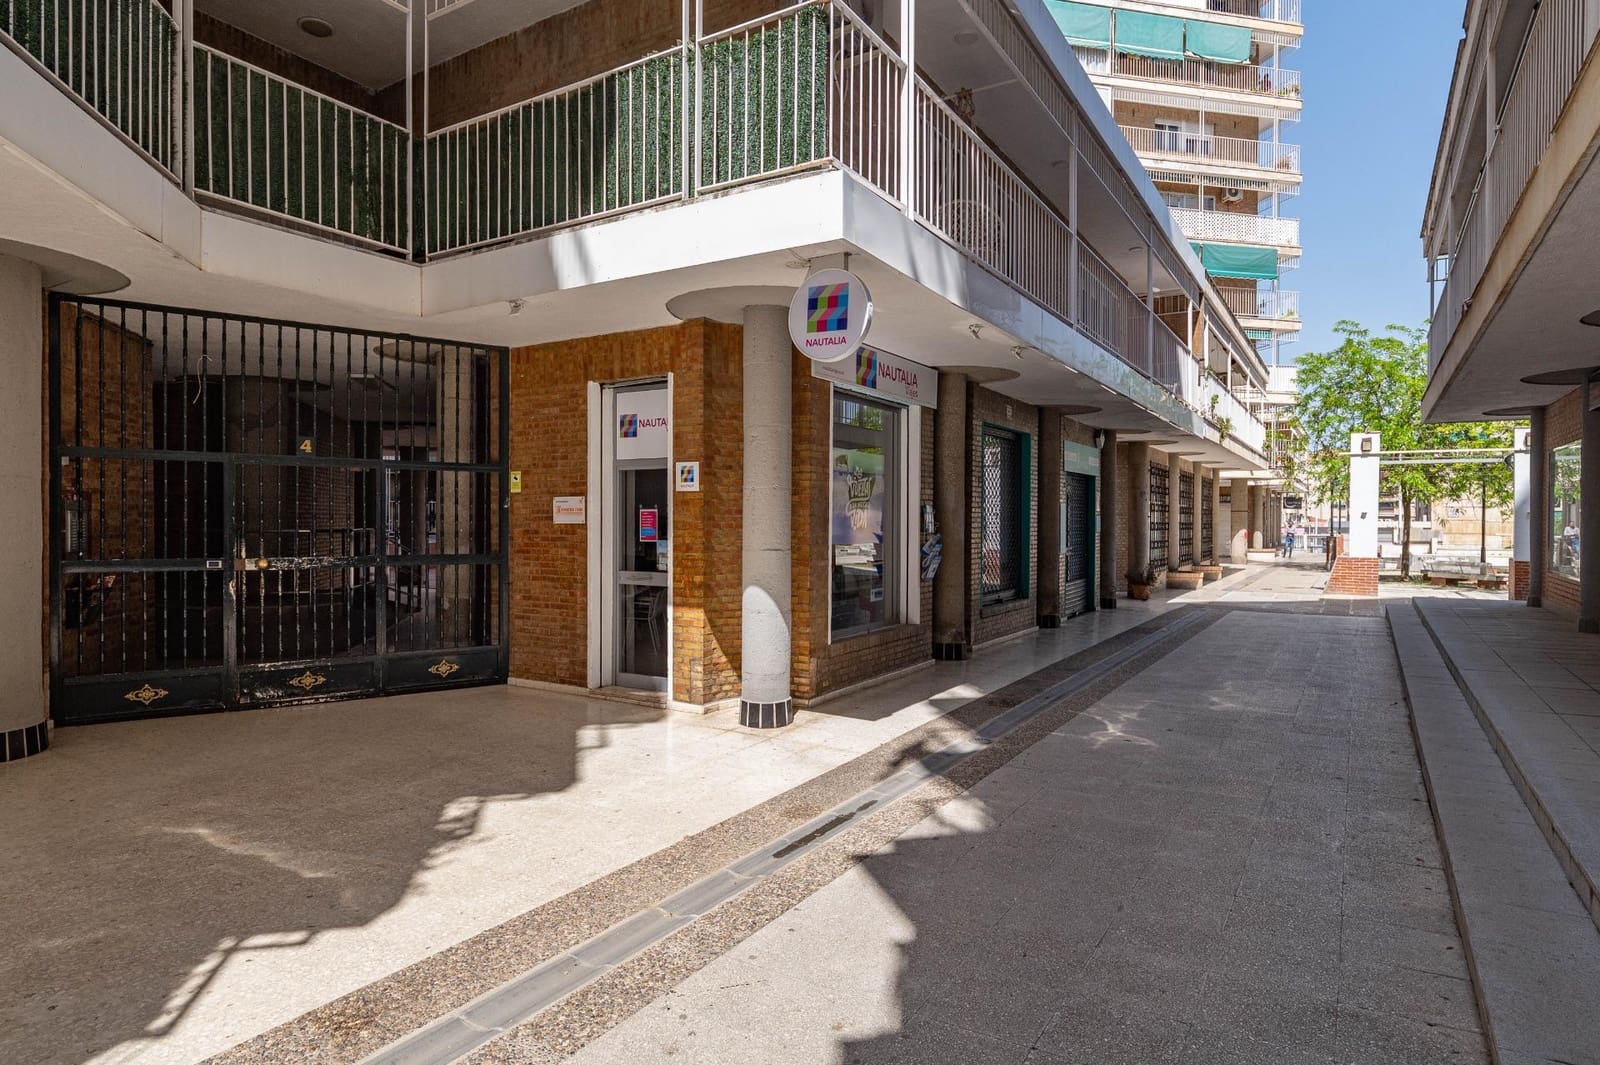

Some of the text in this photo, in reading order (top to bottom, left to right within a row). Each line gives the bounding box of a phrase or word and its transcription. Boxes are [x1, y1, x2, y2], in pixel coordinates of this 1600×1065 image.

[805, 336, 847, 347] NAUTALIA
[878, 362, 918, 388] NAUTALIA
[638, 417, 668, 428] NAUTA
[299, 439, 312, 453] 4
